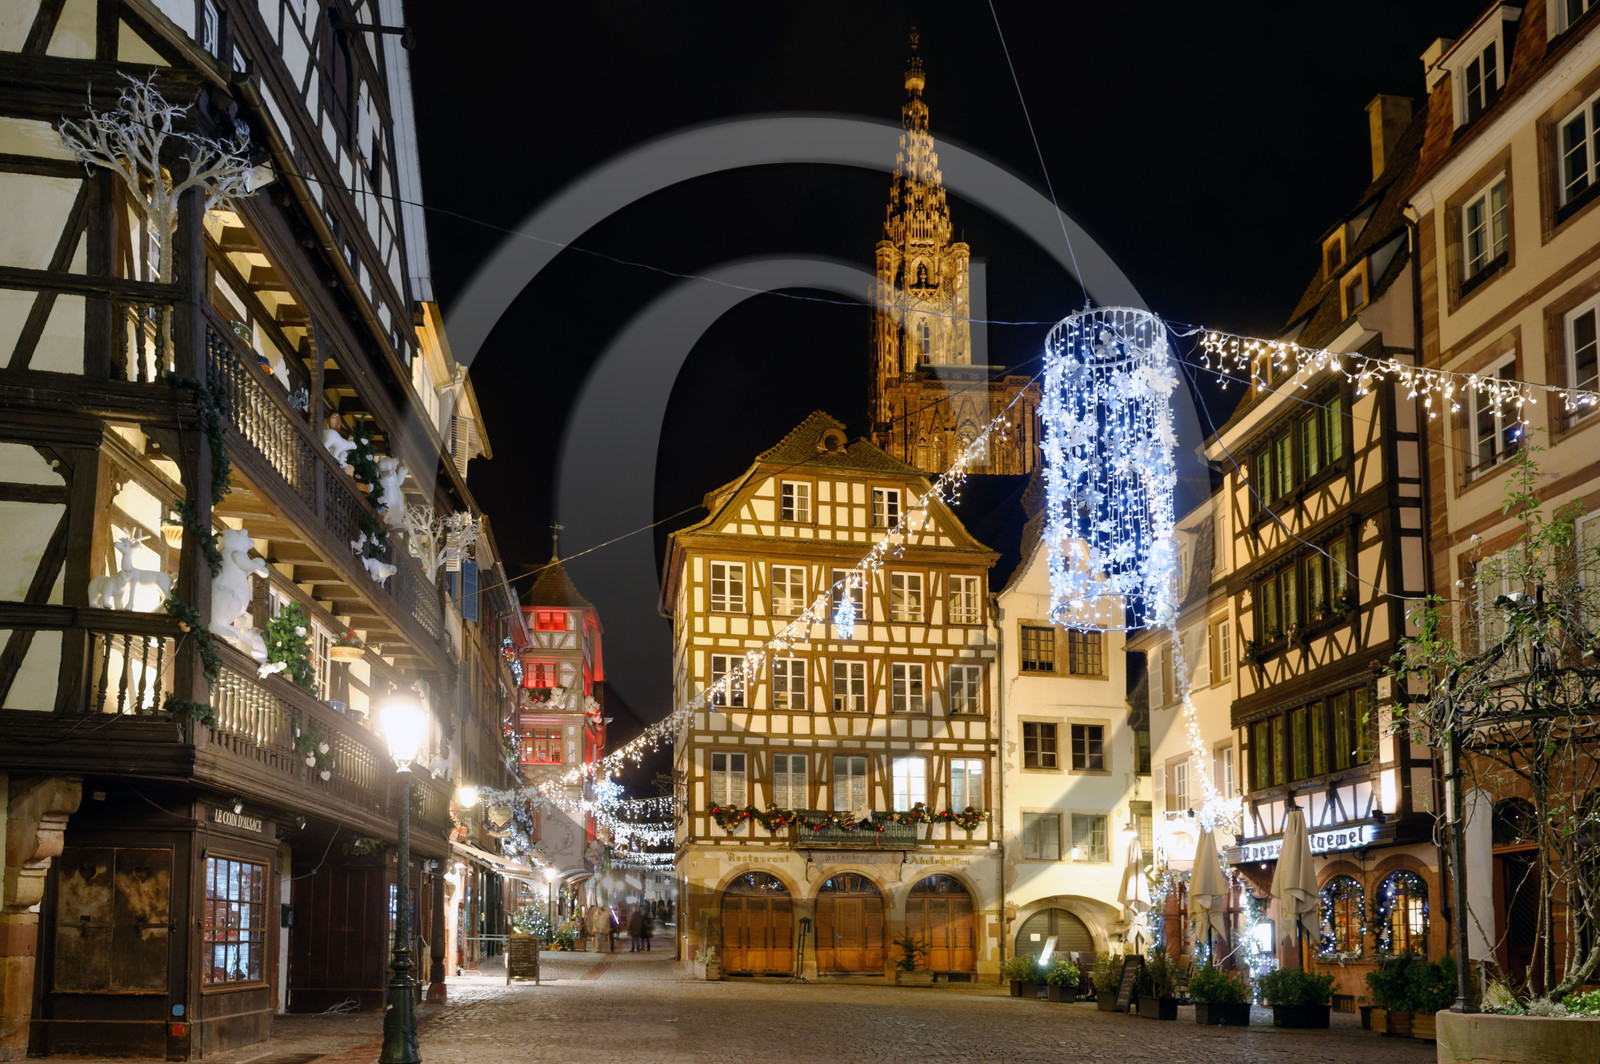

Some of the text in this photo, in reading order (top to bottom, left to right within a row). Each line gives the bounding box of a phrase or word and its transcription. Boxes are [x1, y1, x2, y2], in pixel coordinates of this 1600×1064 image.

[214, 809, 262, 833] LE COIN D'ALSACE
[728, 852, 789, 862] Restaurant
